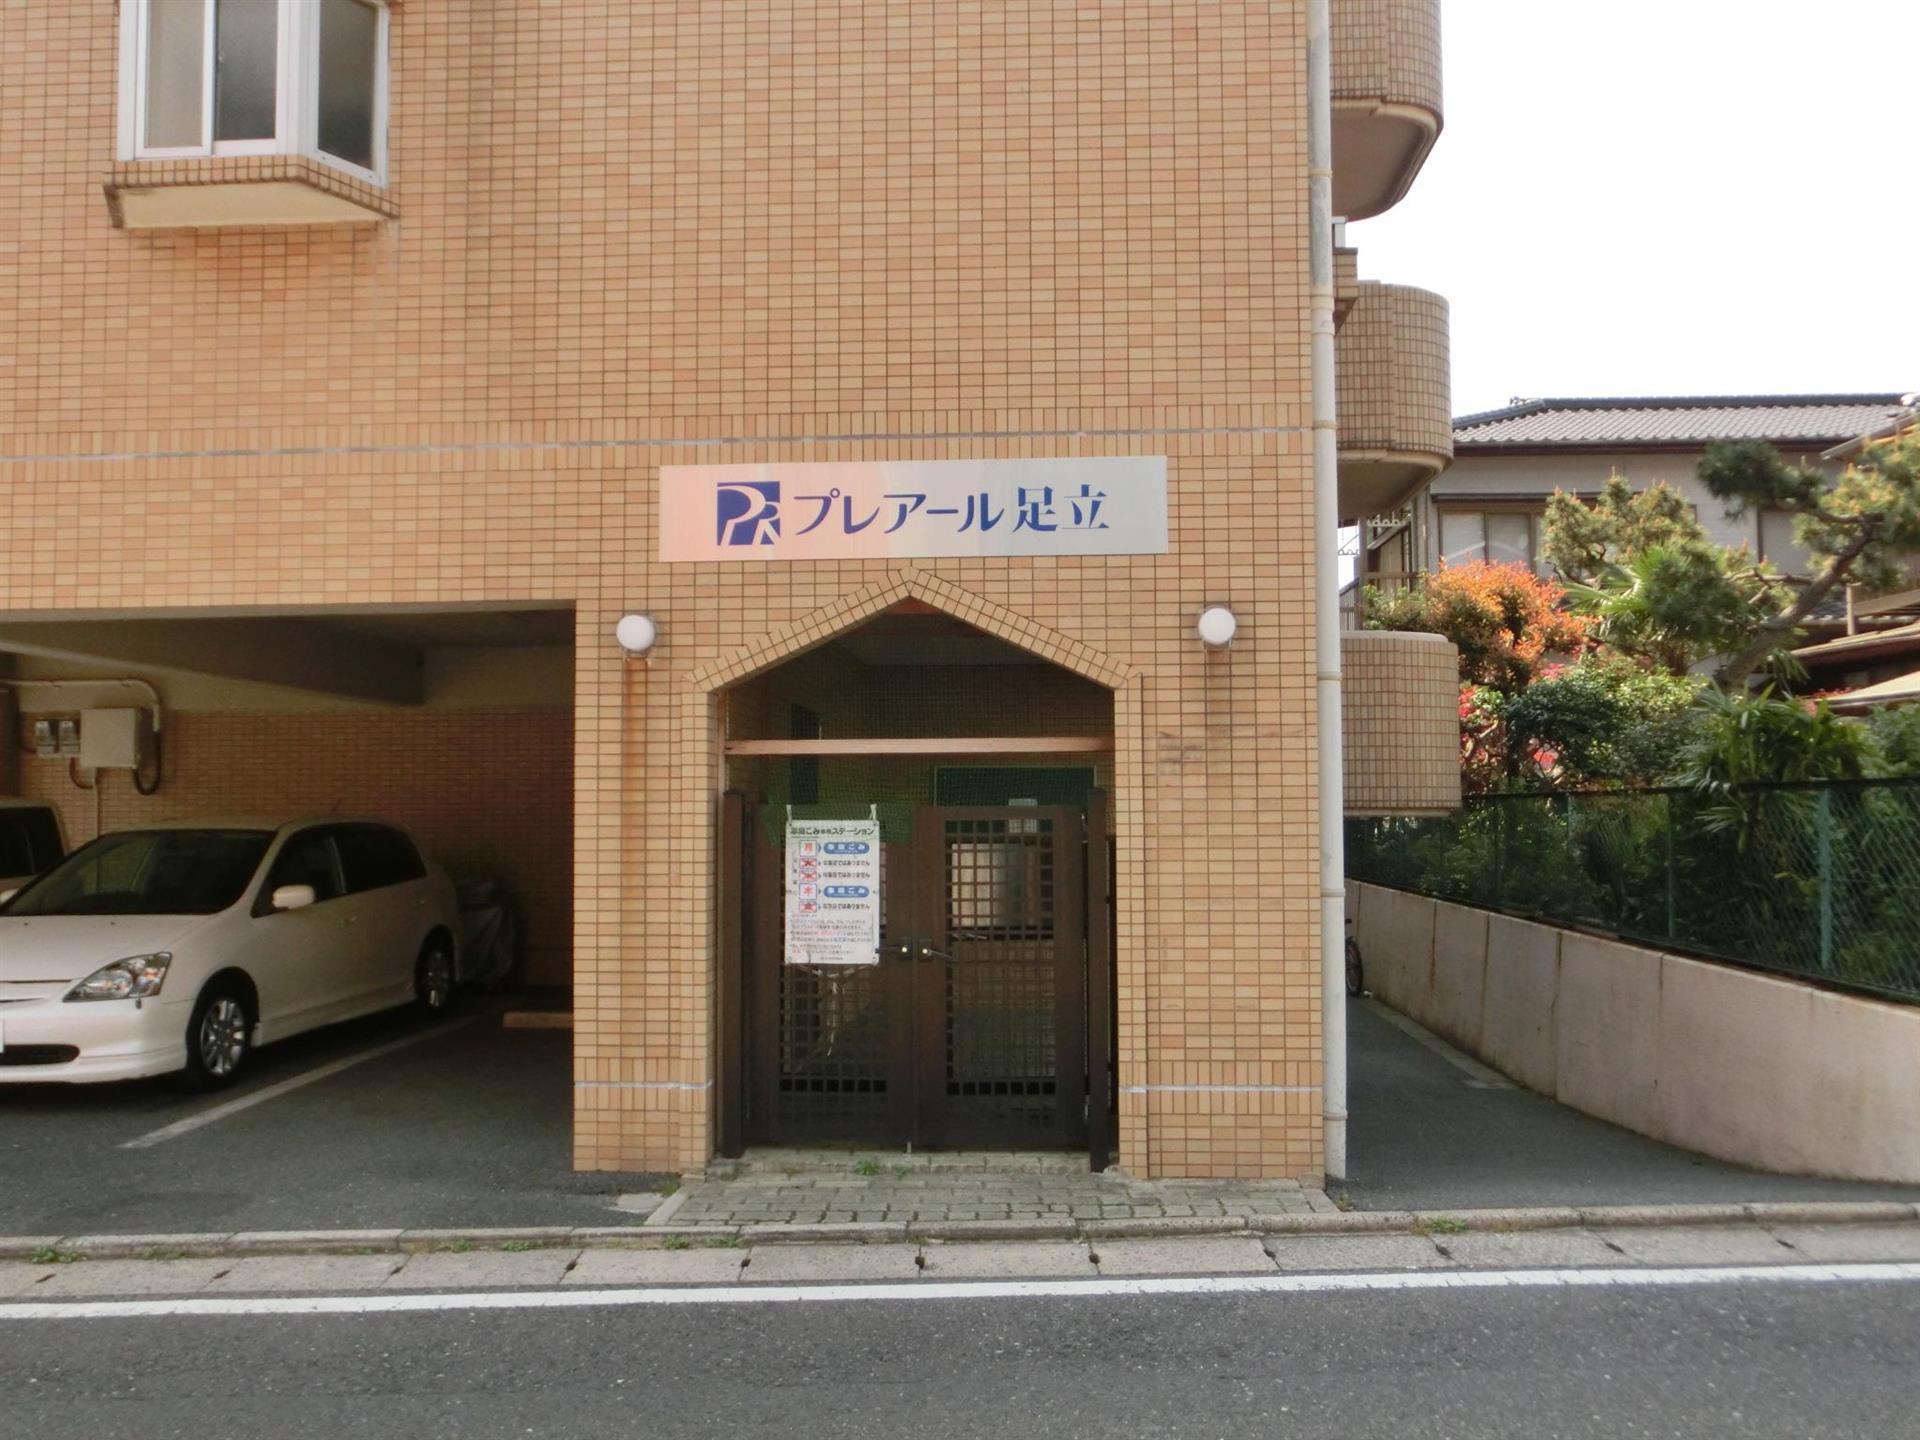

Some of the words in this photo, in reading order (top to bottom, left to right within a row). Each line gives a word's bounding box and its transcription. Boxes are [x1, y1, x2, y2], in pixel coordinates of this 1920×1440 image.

[793, 483, 1109, 536] プレアール足立
